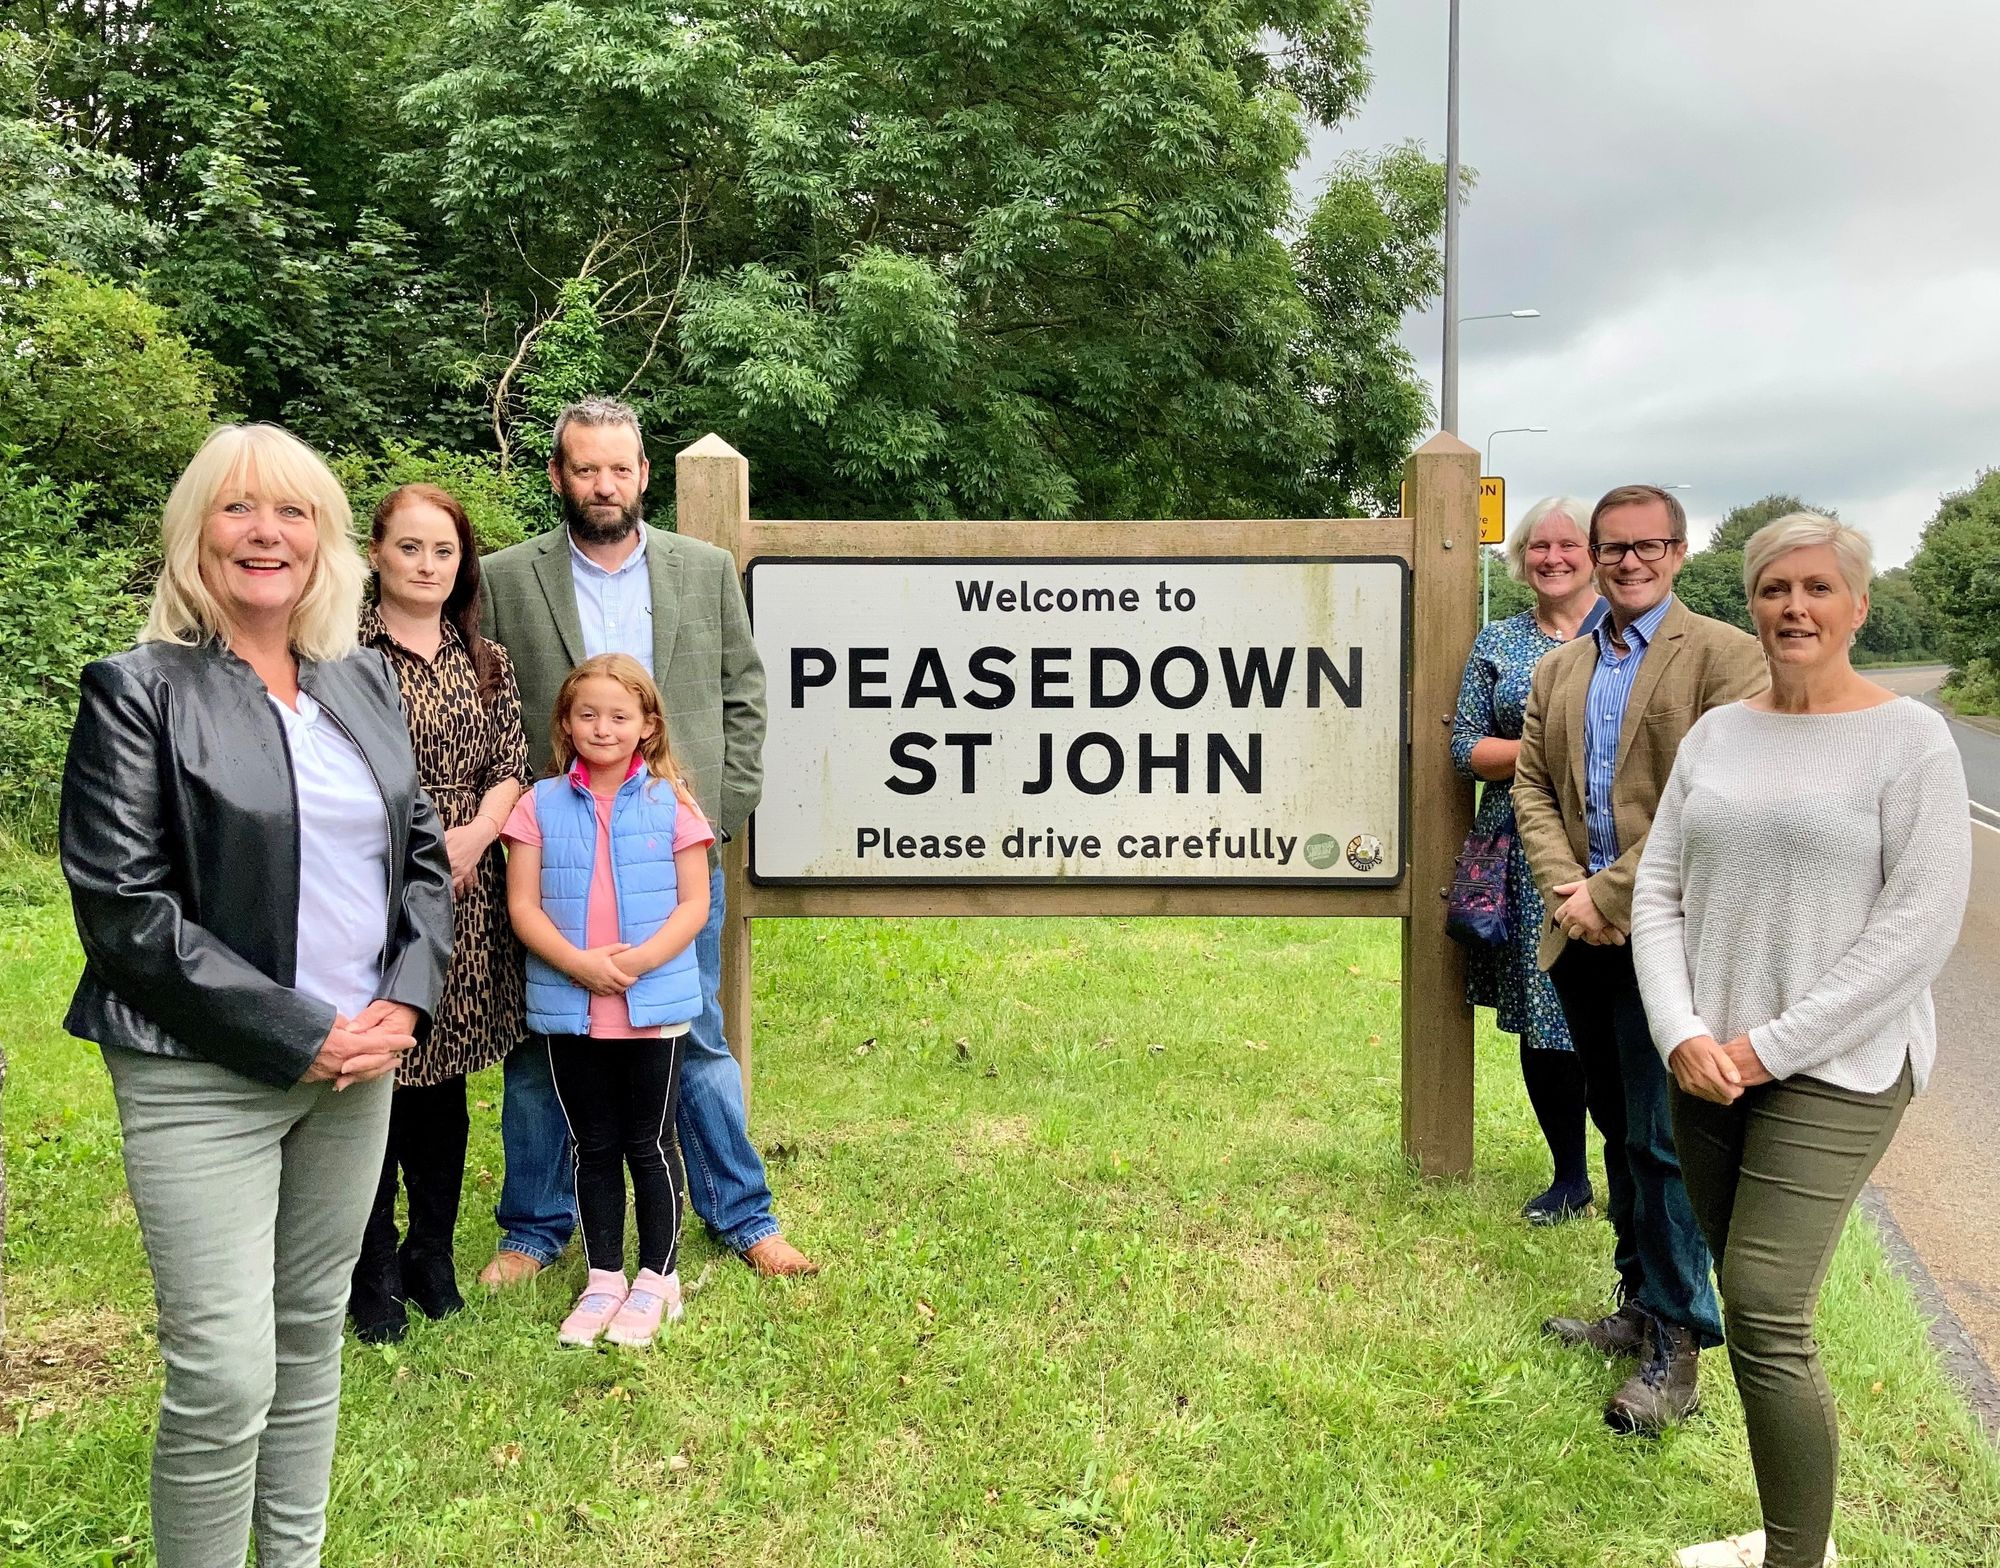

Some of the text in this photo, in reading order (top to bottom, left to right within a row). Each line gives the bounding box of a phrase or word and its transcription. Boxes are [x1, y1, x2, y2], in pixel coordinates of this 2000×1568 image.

[956, 580, 1196, 612] Welcome to
[791, 646, 1363, 709] PEASEDOWN
[884, 731, 1262, 796] ST JOHN
[857, 827, 985, 859] Please
[1001, 827, 1101, 859] drive
[1117, 827, 1298, 866] carefully
